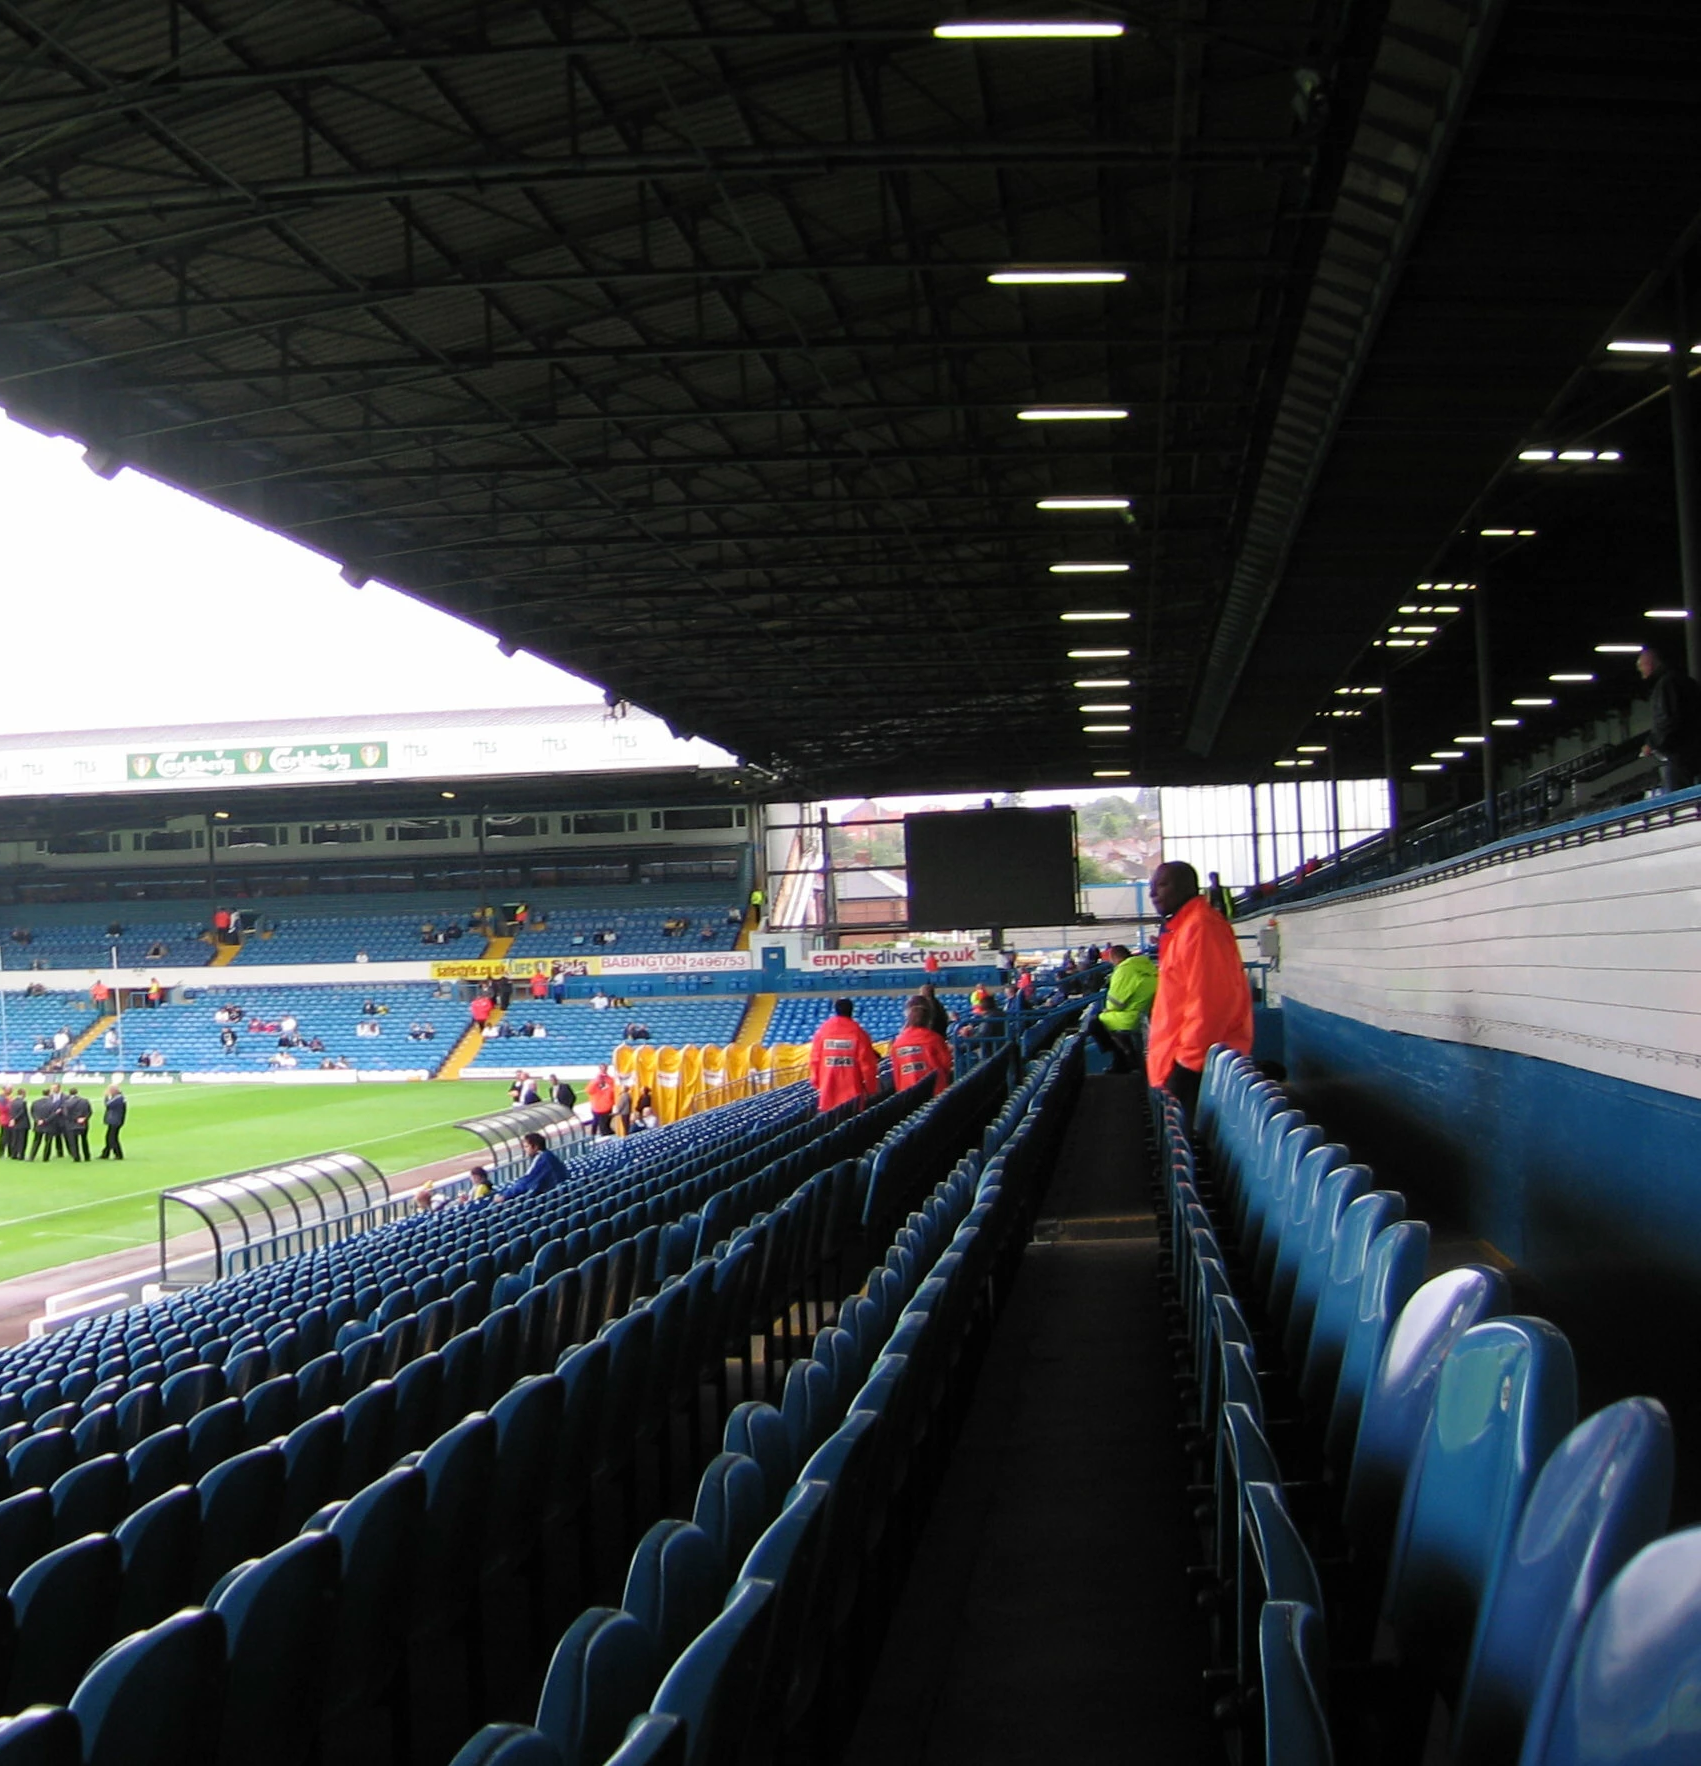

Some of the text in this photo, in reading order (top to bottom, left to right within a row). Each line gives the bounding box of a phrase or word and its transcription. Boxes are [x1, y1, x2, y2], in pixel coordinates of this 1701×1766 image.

[156, 745, 351, 779] Carlsberg Carlsberg
[601, 955, 746, 969] BABINGTON 2496753
